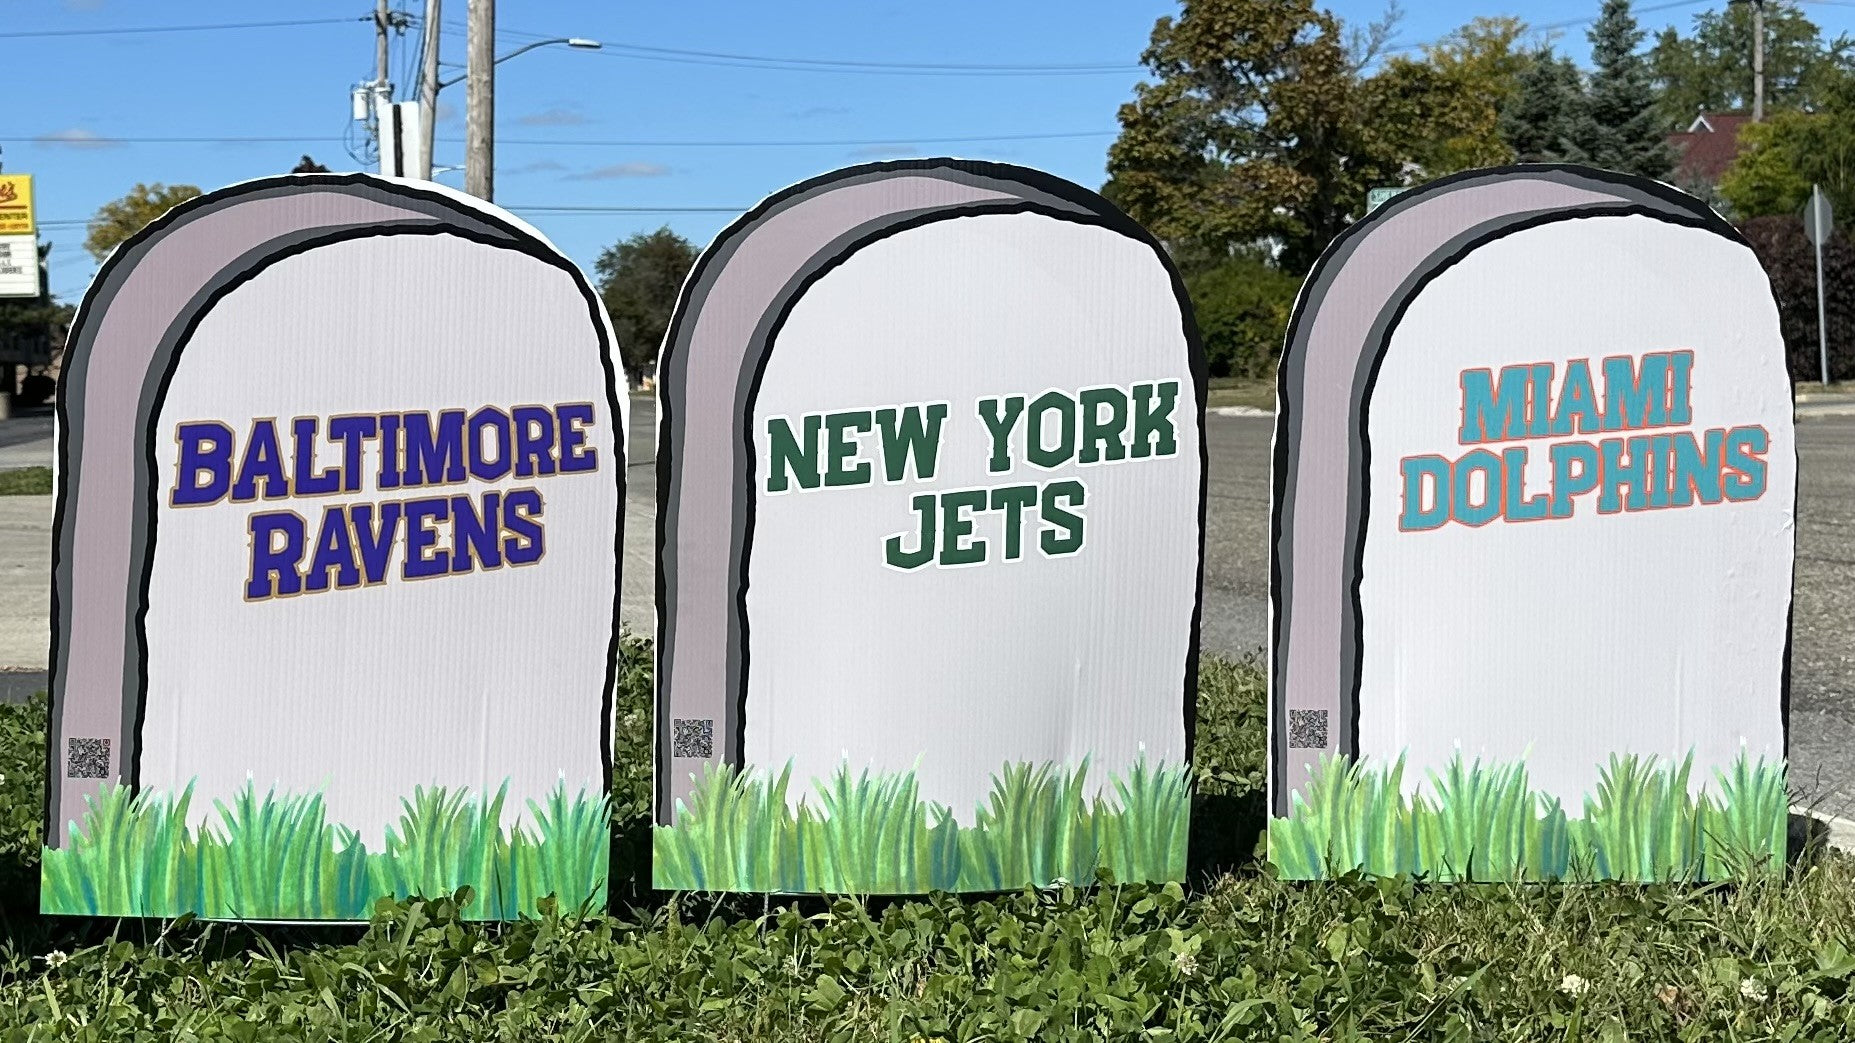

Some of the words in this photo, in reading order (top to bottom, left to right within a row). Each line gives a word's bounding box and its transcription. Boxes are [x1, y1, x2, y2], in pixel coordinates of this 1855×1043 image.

[764, 401, 951, 496] NEW
[976, 378, 1182, 475] YORK
[1459, 350, 1694, 445] MIAMI
[169, 402, 598, 508] BALTIMORE
[1399, 424, 1769, 532] DOLPHINS
[243, 487, 546, 602] RAVENS
[883, 477, 1087, 572] JETS
